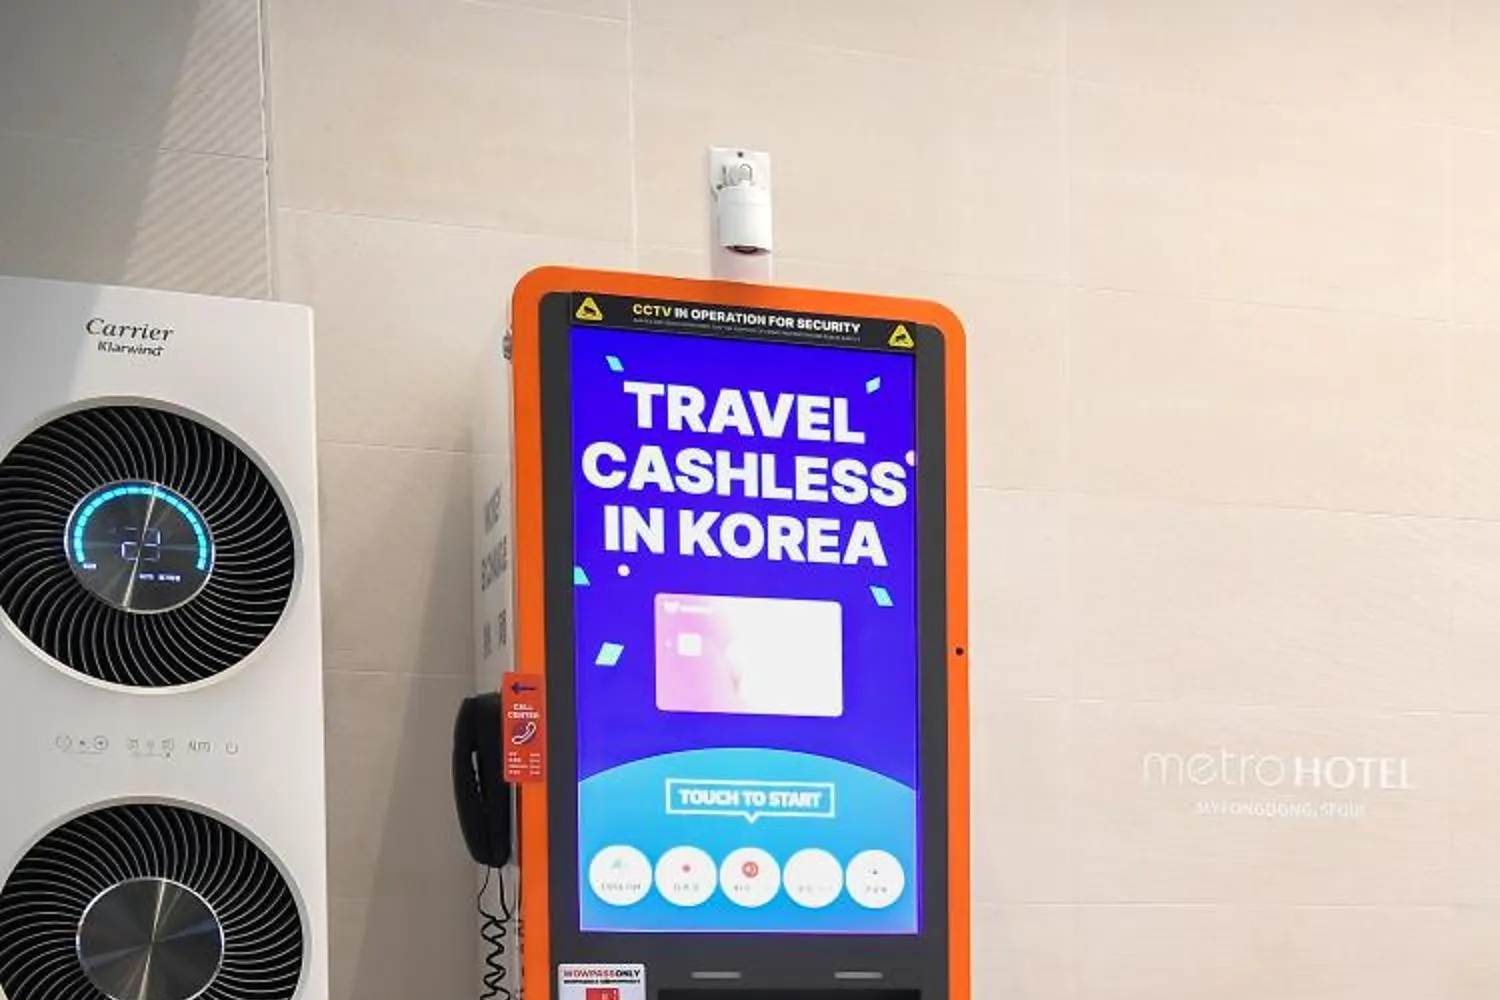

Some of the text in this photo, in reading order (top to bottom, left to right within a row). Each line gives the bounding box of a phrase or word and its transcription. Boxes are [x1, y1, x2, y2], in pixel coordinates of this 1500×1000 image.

[86, 317, 175, 341] Carrier
[633, 303, 672, 317] CCTV
[674, 307, 688, 319] IN
[690, 309, 766, 326] OPERATION
[768, 315, 794, 328] FOR
[797, 318, 861, 333] SECURITY
[623, 380, 866, 445] TRAVEL
[581, 441, 907, 507] CASHLESS
[603, 505, 888, 567] IN KOREA
[1143, 747, 1416, 791] metro HOTEL
[678, 788, 823, 809] TOUCH TO START
